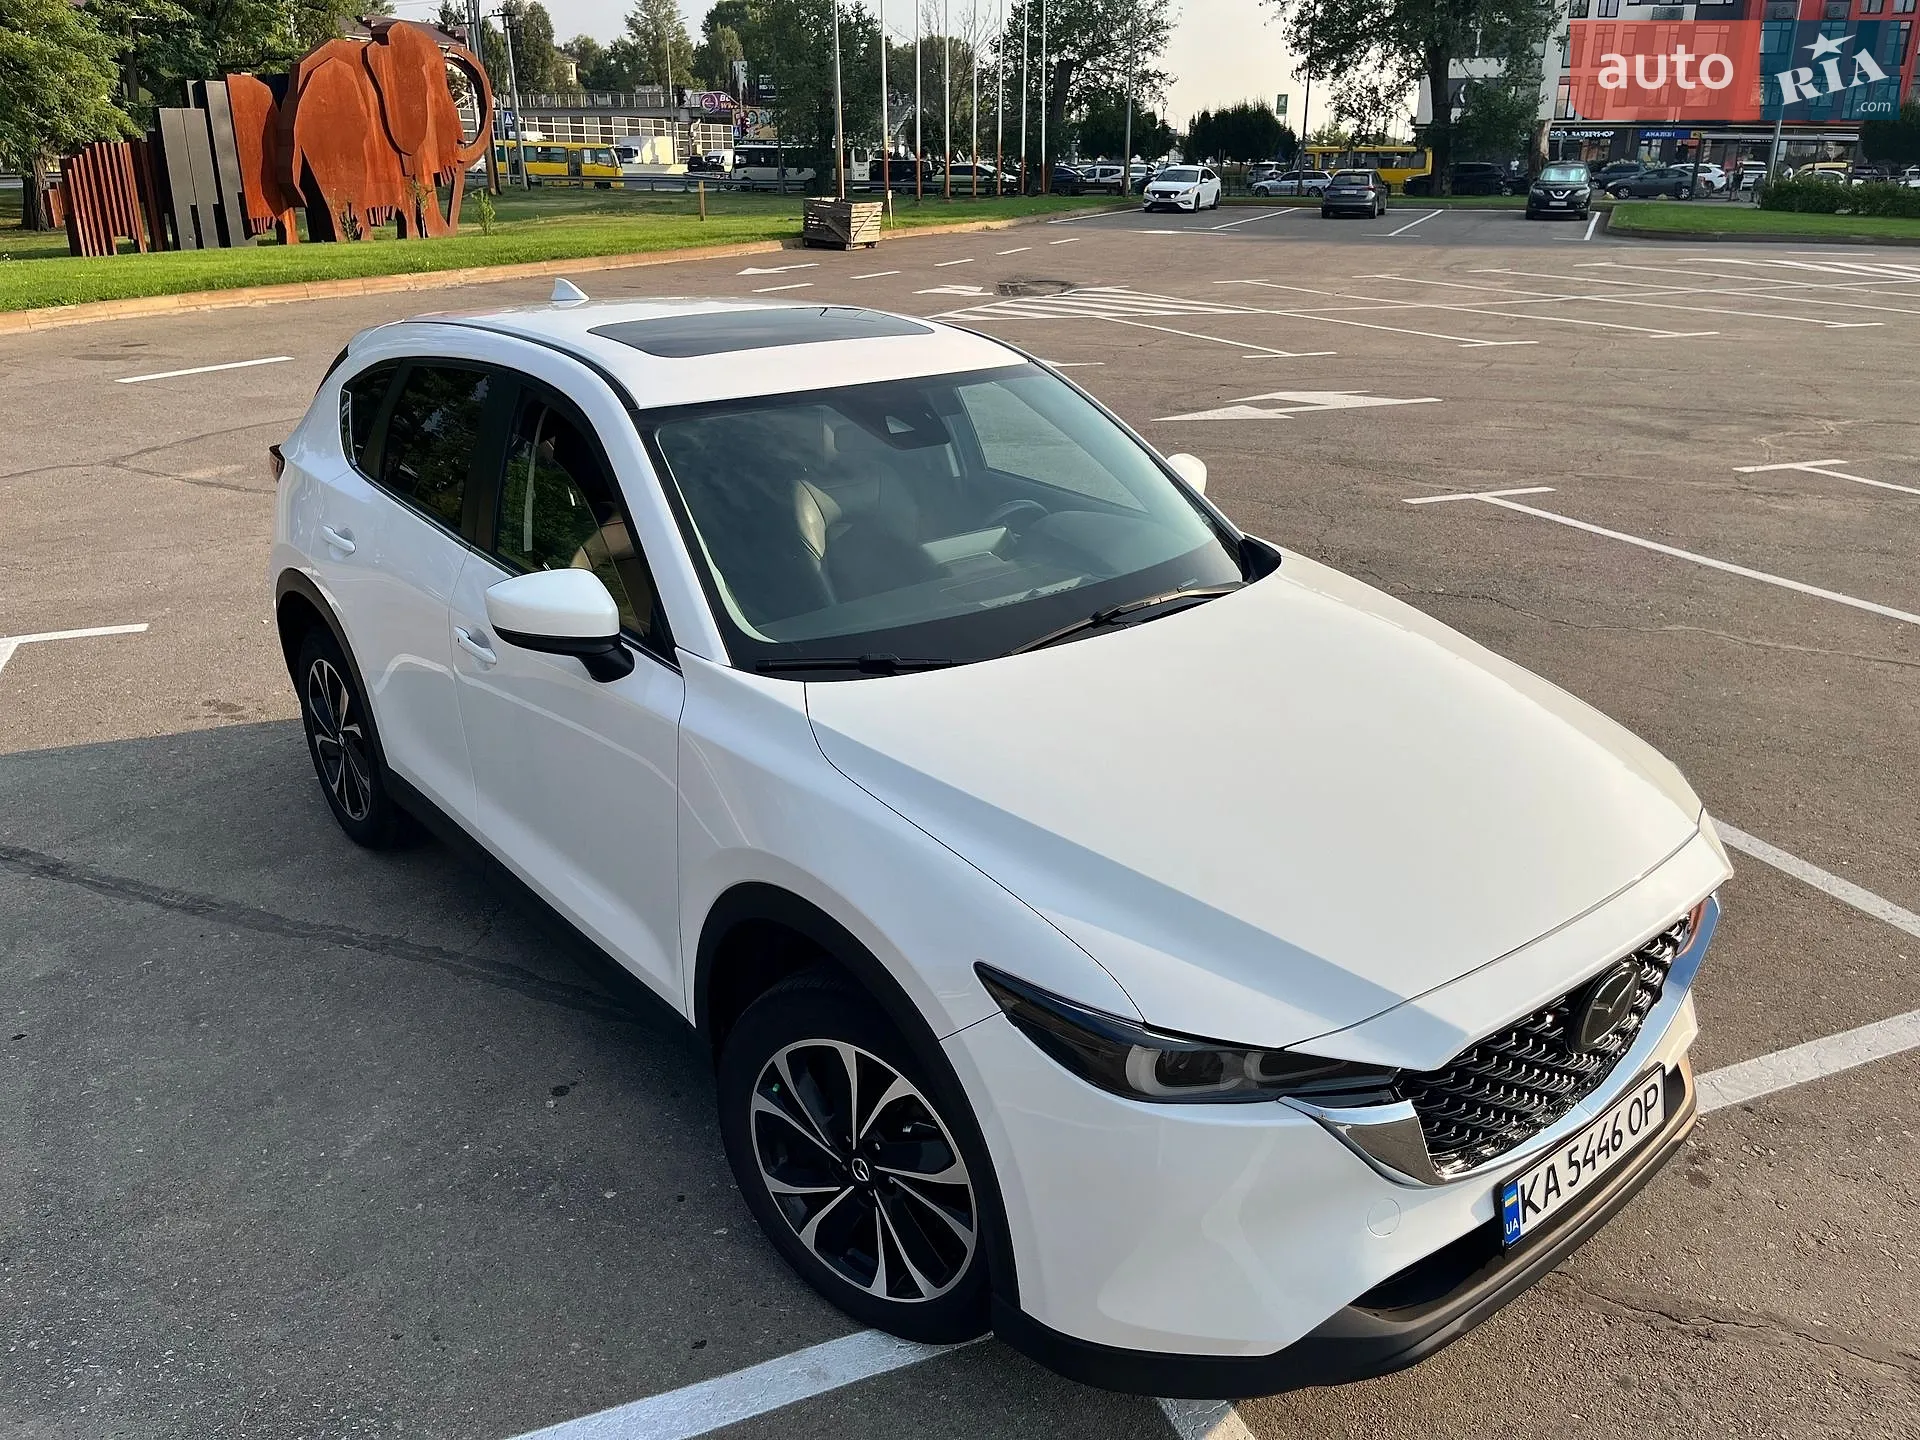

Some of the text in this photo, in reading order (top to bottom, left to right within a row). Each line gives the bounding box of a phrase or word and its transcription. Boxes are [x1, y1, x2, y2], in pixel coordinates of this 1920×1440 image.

[1520, 1083, 1659, 1225] KA 5446 OP
[1505, 1217, 1519, 1235] UA
